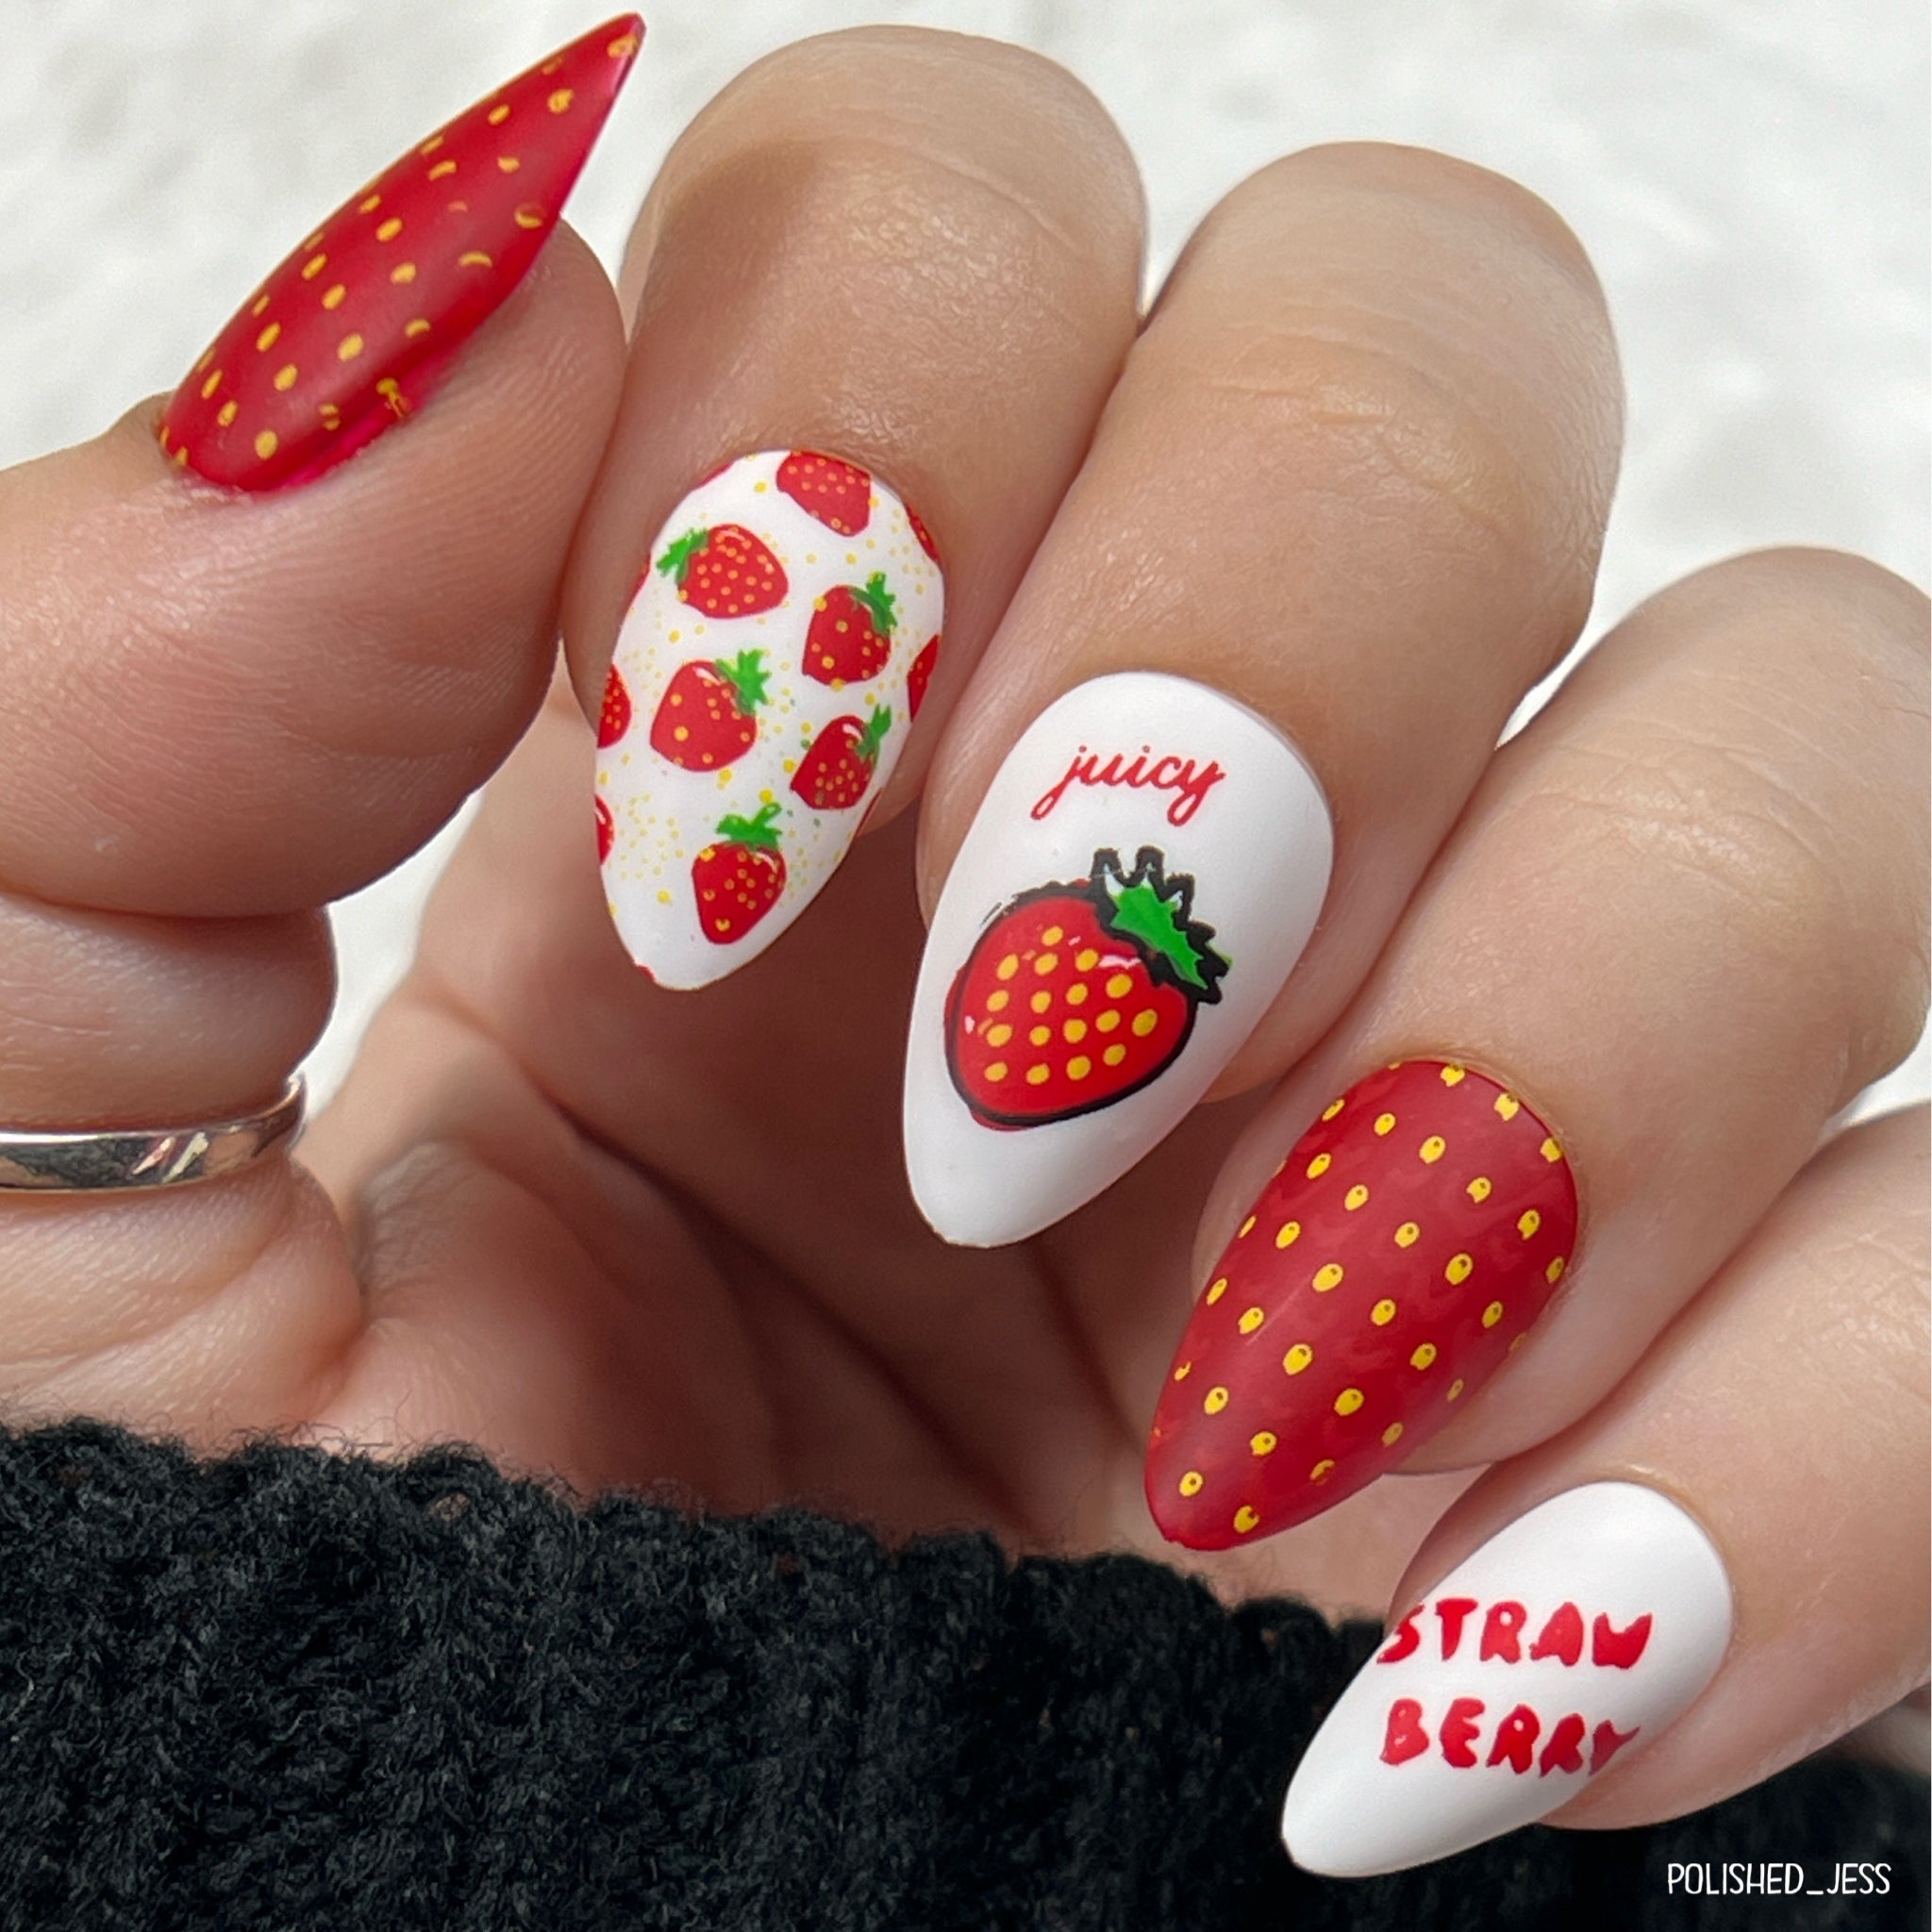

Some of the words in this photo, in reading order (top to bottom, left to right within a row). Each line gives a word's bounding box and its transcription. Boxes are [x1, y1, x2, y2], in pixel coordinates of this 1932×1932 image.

[1030, 744, 1225, 826] juicy
[1377, 1597, 1653, 1670] STRAW
[1380, 1697, 1641, 1777] BERRY
